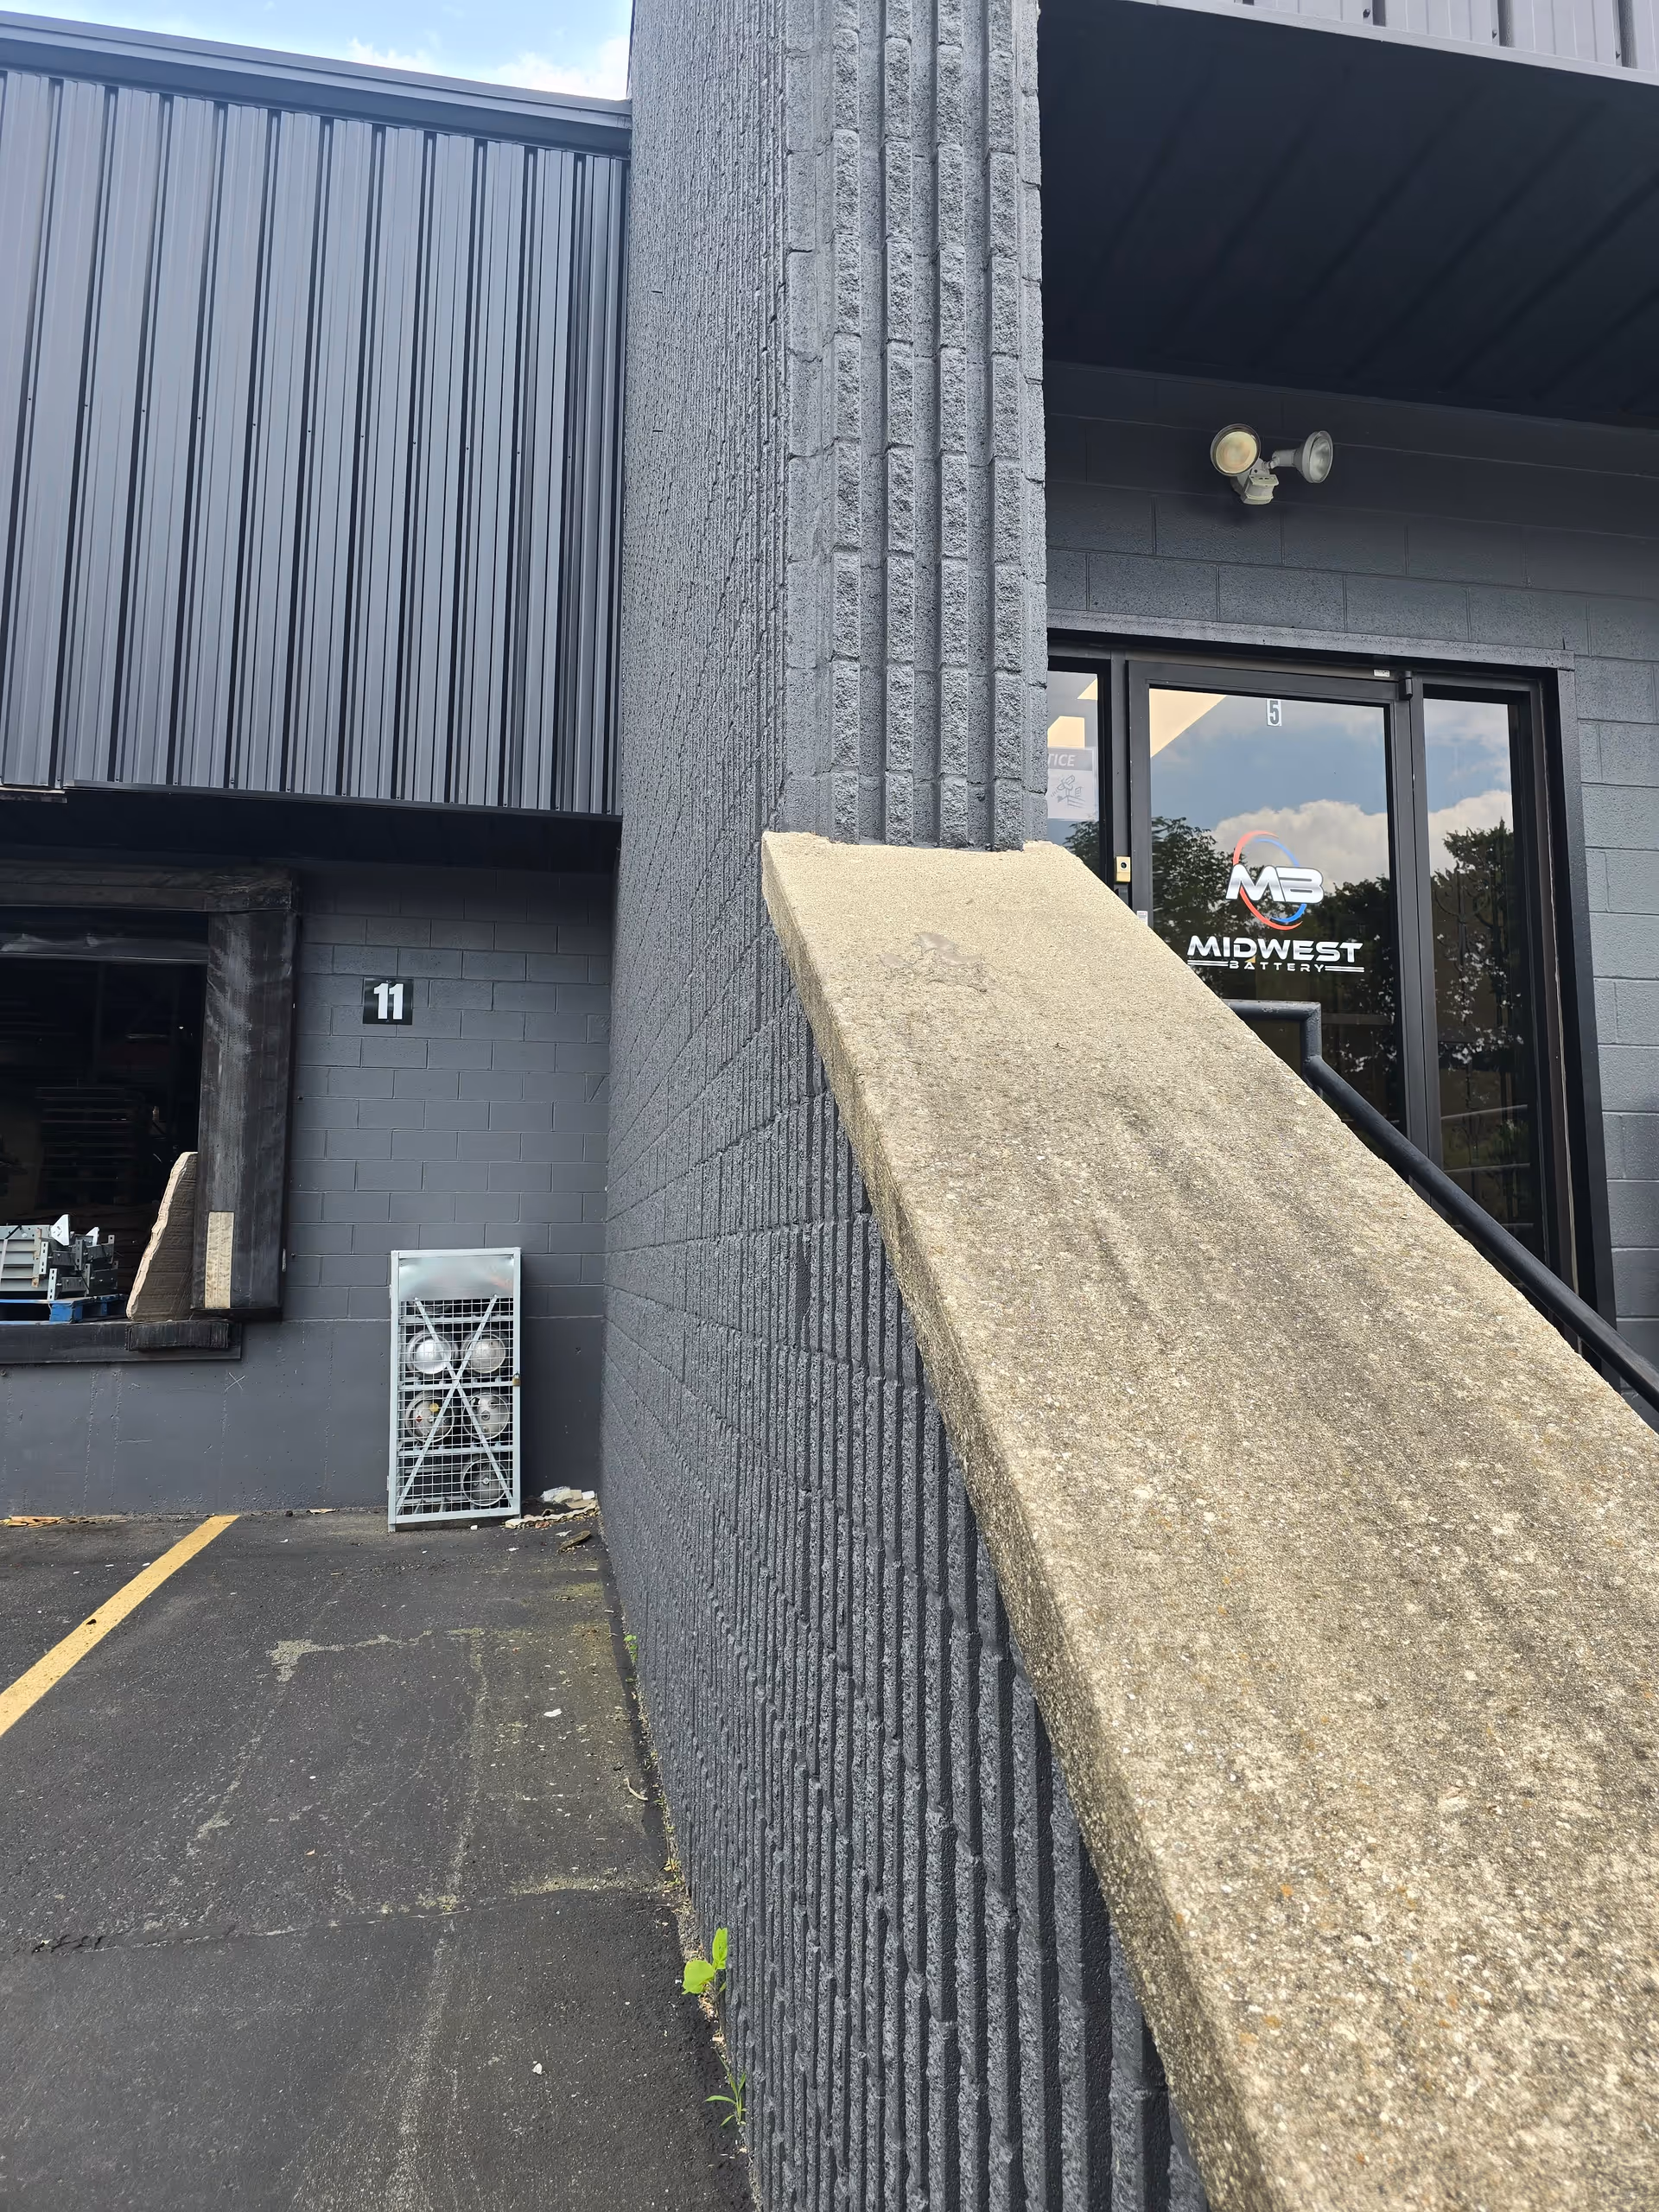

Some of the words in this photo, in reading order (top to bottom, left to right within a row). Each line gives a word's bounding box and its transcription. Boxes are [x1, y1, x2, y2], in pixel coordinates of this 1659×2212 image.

[1270, 700, 1279, 724] 5
[1225, 863, 1324, 904] MB
[1186, 935, 1363, 963] MIDWEST
[1229, 960, 1325, 972] BATTERY
[373, 982, 404, 1020] 11
